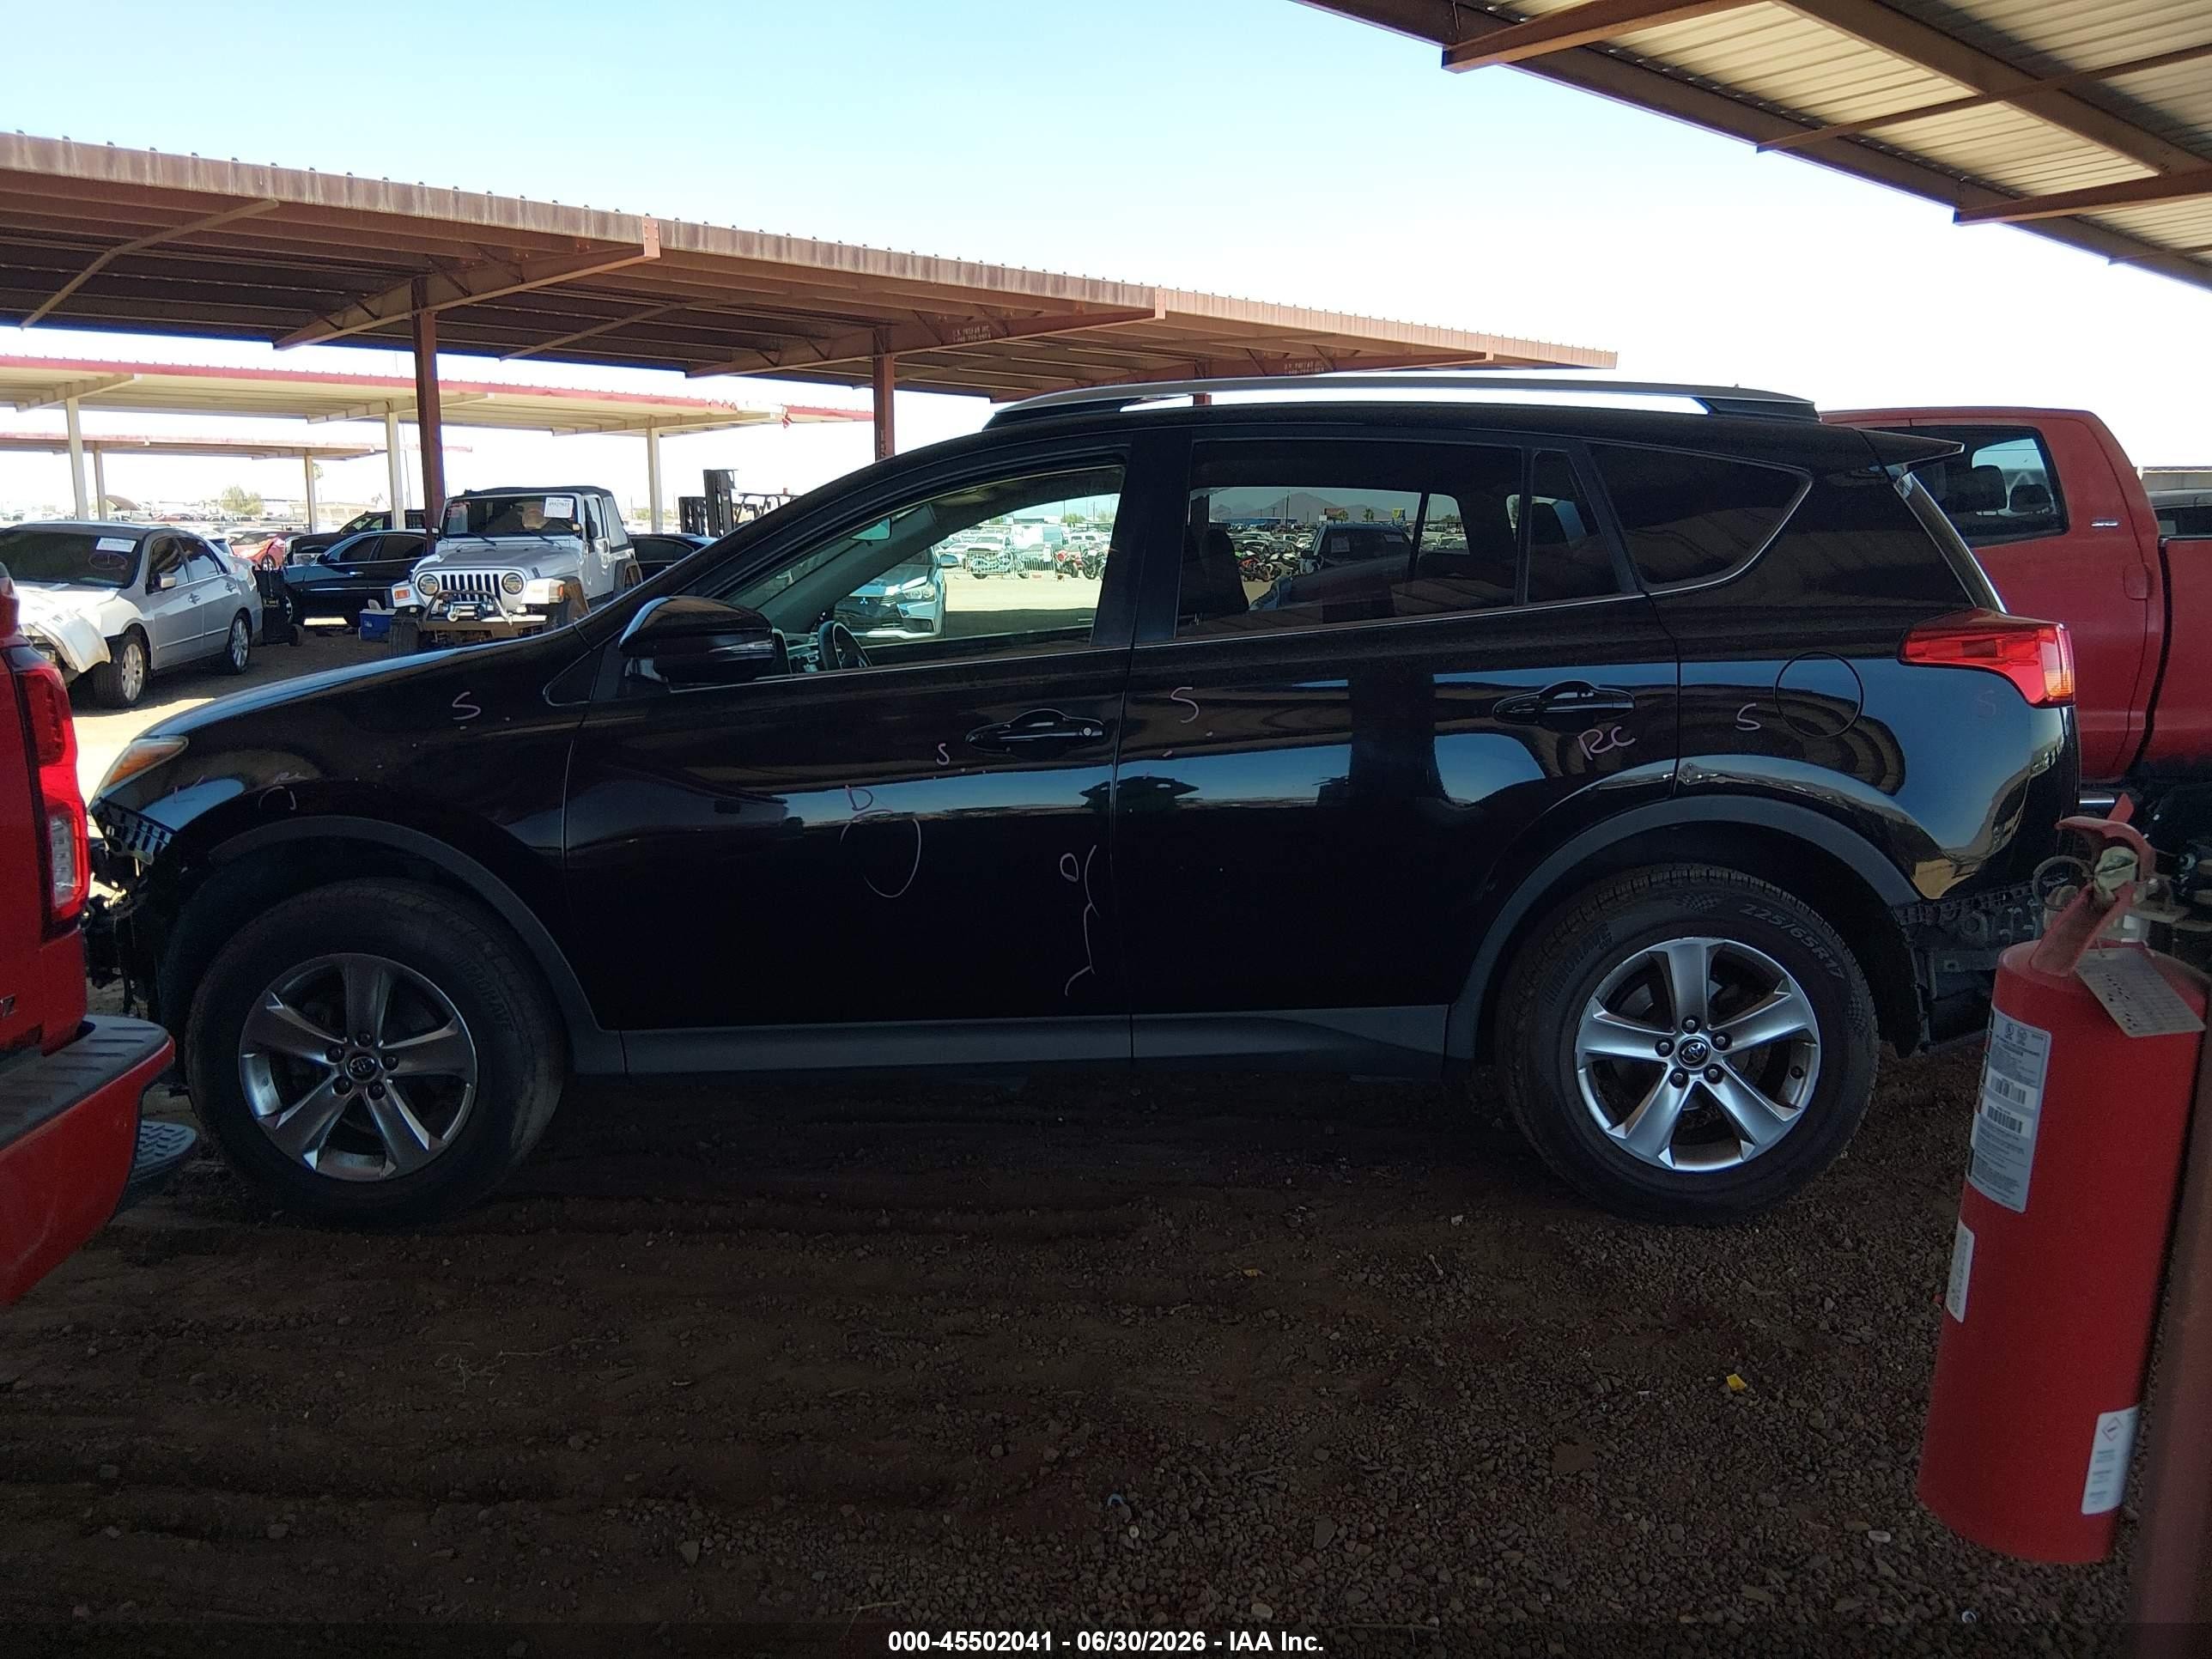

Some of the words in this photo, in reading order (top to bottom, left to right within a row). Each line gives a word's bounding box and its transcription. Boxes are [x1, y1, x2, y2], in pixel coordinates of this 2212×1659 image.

[452, 690, 482, 720] S
[1170, 686, 1200, 723] S
[1735, 702, 1761, 731] S
[936, 743, 951, 766] S
[1577, 726, 1636, 761] RC
[1738, 902, 1846, 980] 225/65R17
